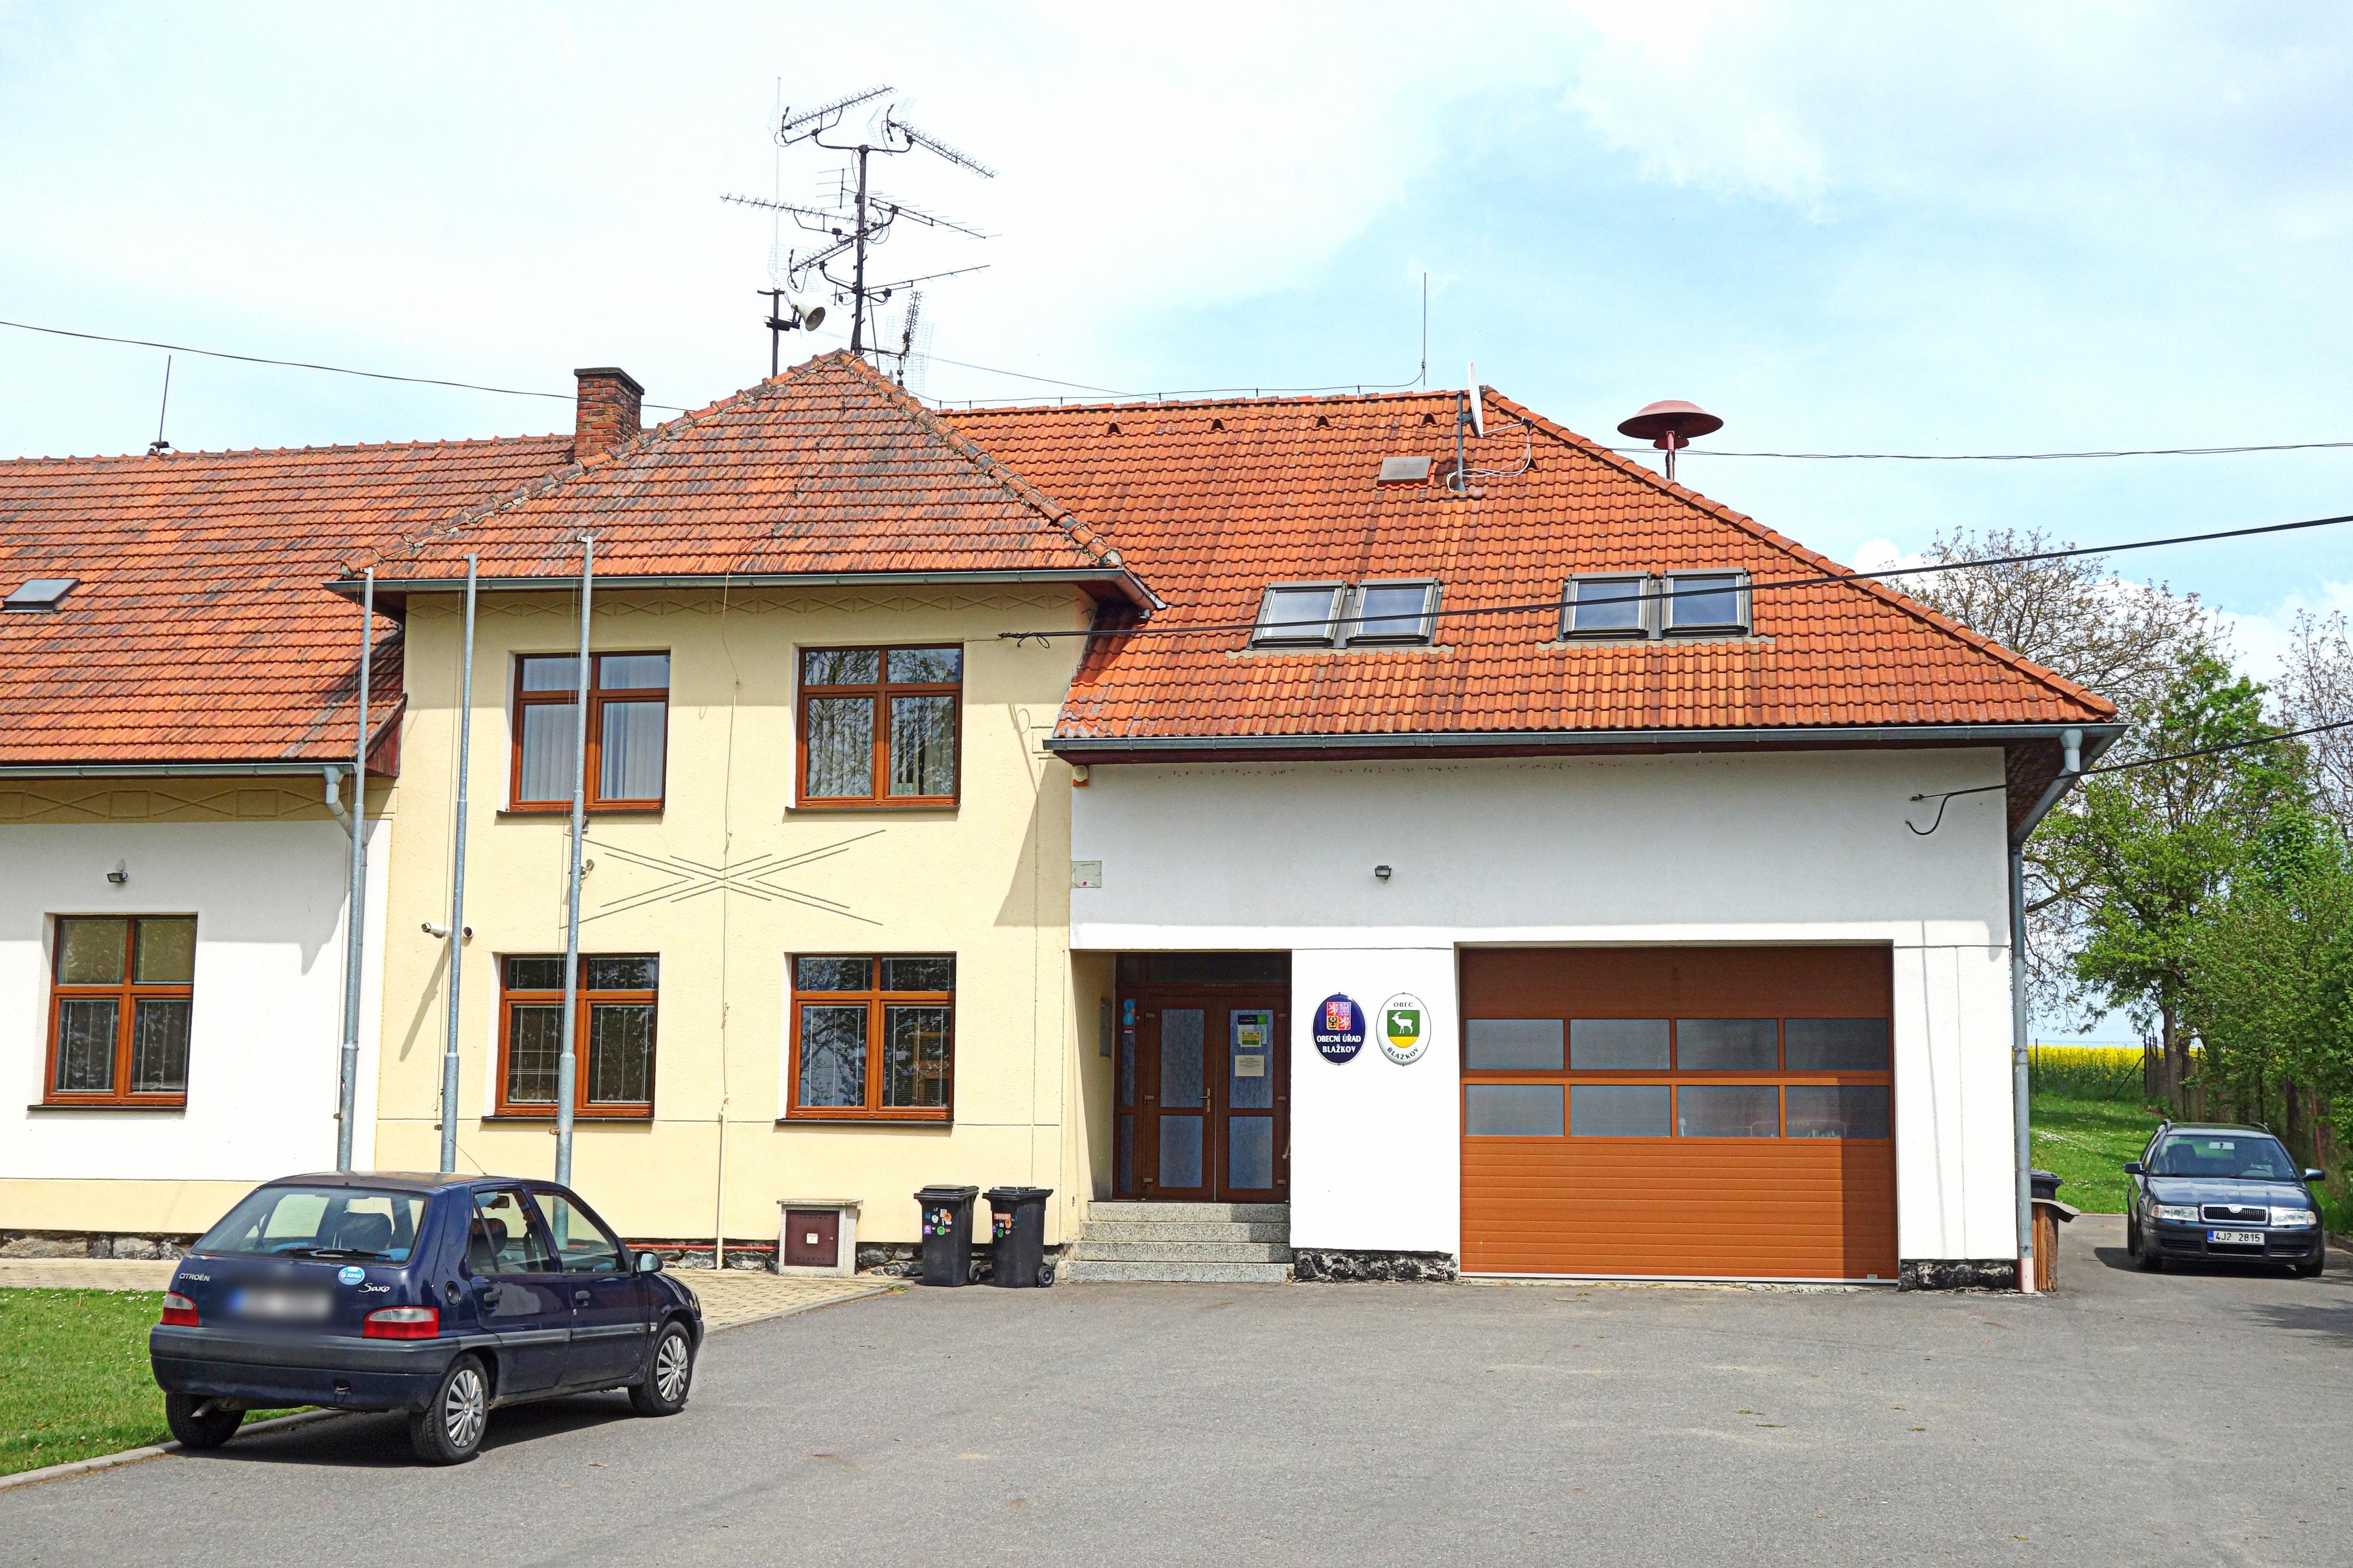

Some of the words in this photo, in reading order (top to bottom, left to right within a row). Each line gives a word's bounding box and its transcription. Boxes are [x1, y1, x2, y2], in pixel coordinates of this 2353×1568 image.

[1317, 1033, 1341, 1043] OBECNÍ
[1342, 1033, 1361, 1043] ÚŘAD
[1322, 1044, 1356, 1053] BLAŽKOV
[1387, 1046, 1419, 1060] BLAŽKOV
[2215, 1232, 2232, 1241] 4J2
[2238, 1233, 2261, 1242] 2815
[179, 1273, 211, 1282] CITROËN
[358, 1282, 391, 1293] Saxo
